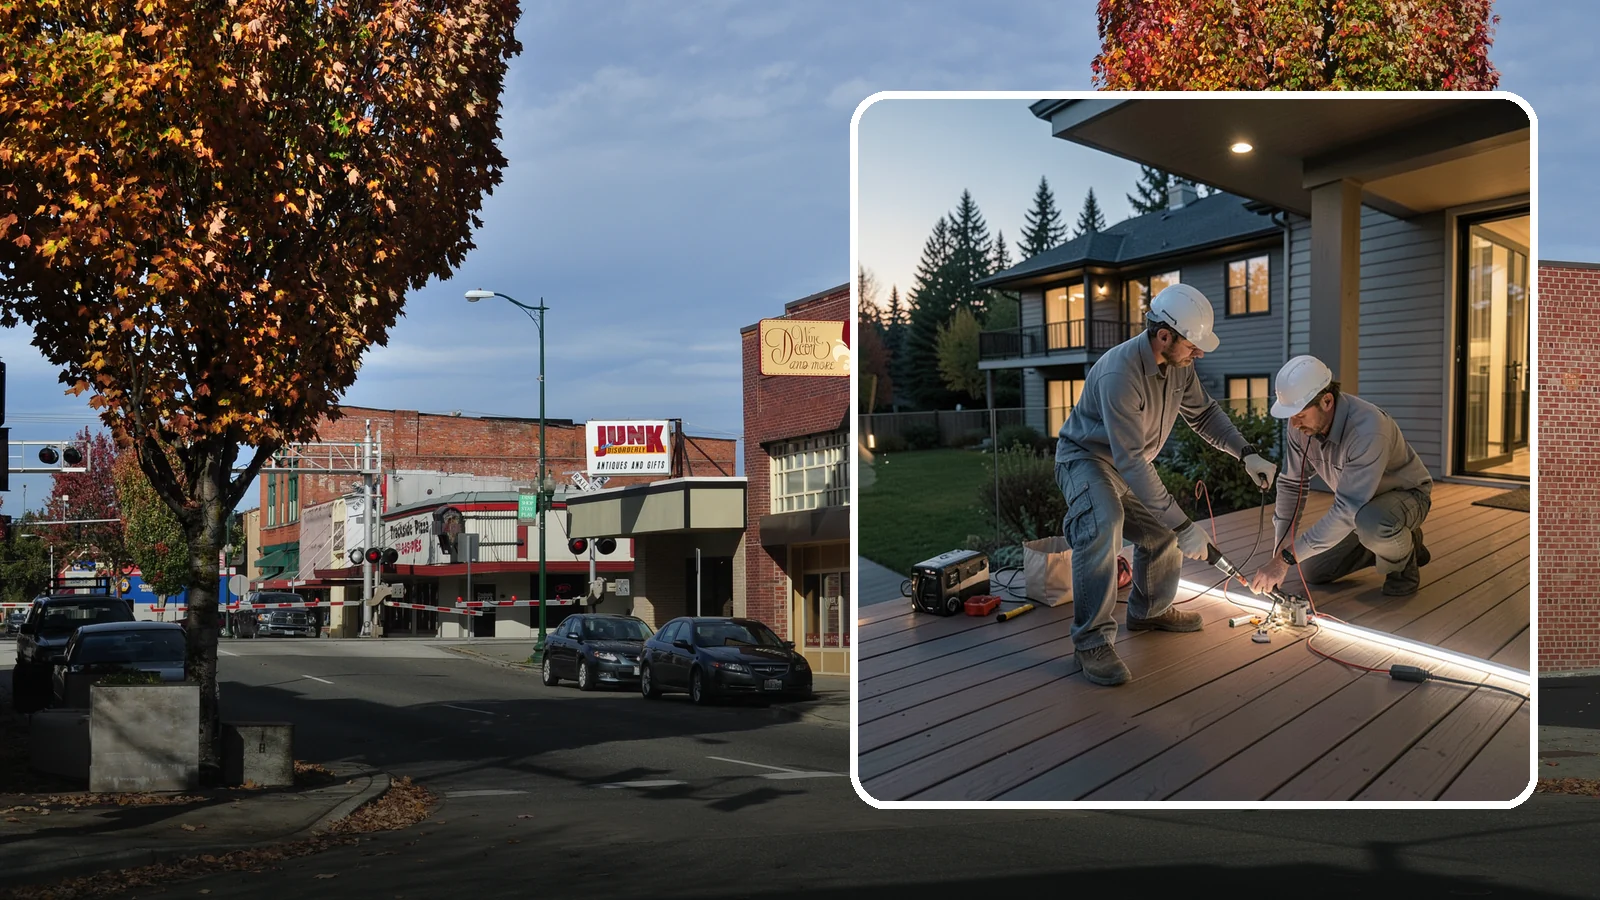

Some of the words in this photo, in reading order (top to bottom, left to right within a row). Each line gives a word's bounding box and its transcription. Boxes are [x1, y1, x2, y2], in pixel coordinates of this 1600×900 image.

[596, 425, 664, 457] JUNK
[597, 461, 628, 470] ANTIQUES
[631, 461, 644, 469] AND
[647, 461, 665, 469] GIFTS
[390, 522, 412, 539] Trackside
[415, 520, 429, 534] Pizza
